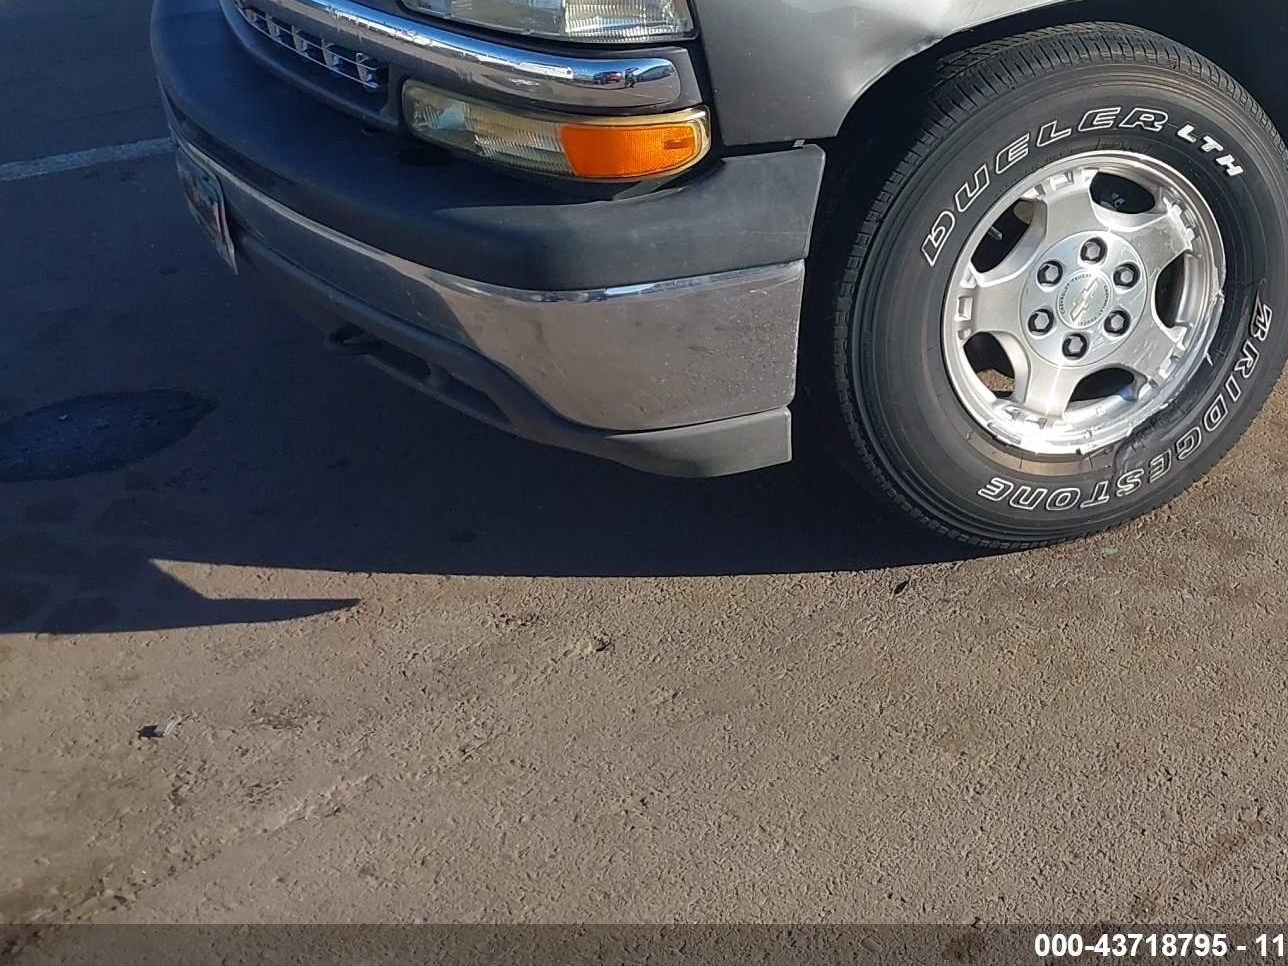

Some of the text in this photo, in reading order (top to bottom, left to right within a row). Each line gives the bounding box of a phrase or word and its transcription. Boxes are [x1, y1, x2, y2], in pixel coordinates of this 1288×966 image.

[921, 106, 1244, 267] DUELER LTH
[978, 298, 1272, 511] BRIDGESTONE
